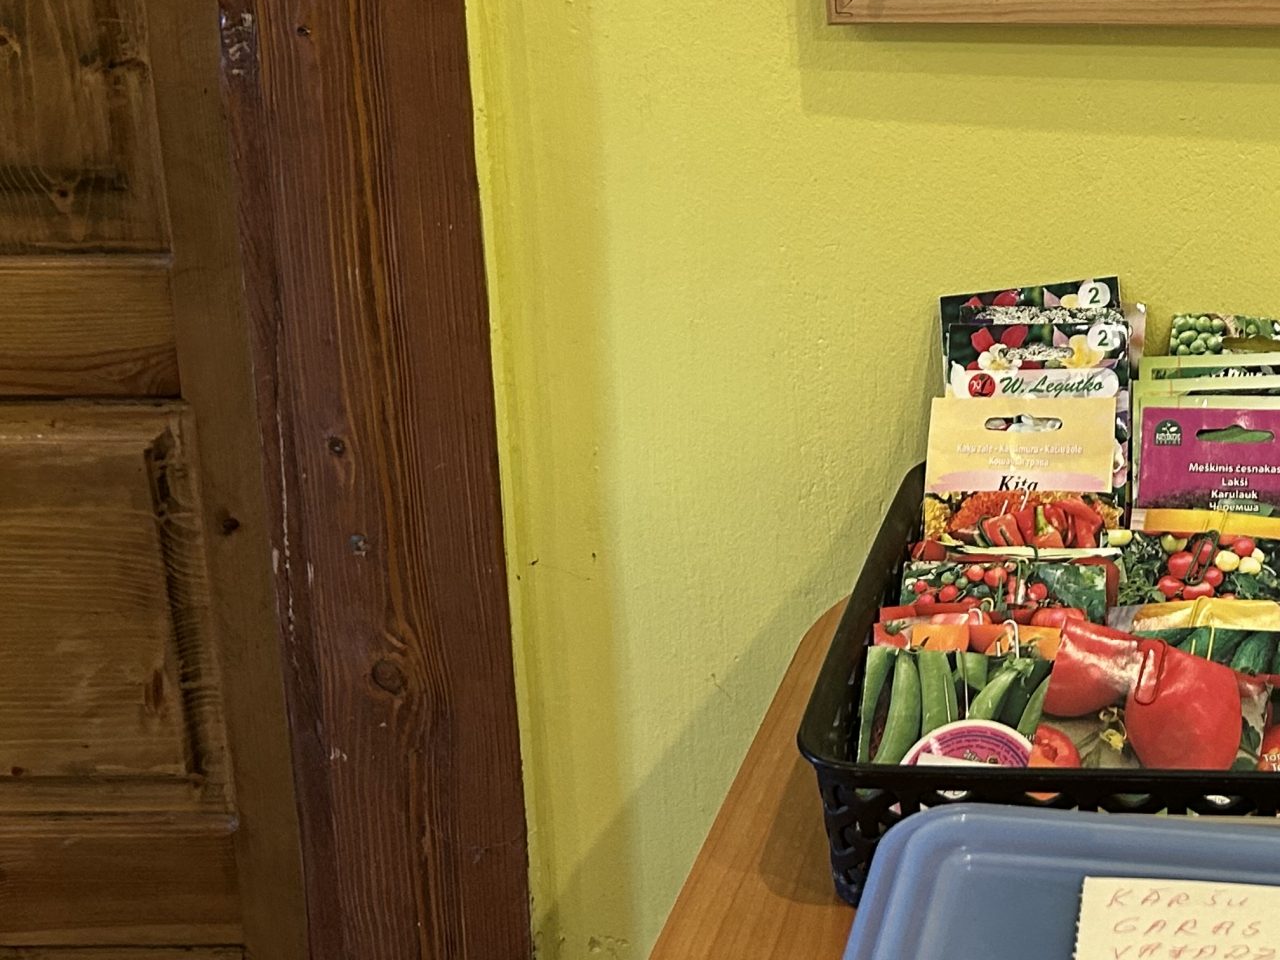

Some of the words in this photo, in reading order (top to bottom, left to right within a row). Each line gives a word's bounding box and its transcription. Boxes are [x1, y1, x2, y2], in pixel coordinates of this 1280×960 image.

[1089, 288, 1100, 304] 2
[1098, 330, 1109, 346] 2
[1000, 376, 1025, 394] W.
[1029, 375, 1104, 398] Legutko
[1188, 463, 1233, 473] Meškinis
[1221, 477, 1248, 487] Lakši
[1211, 490, 1258, 500] Karulauk
